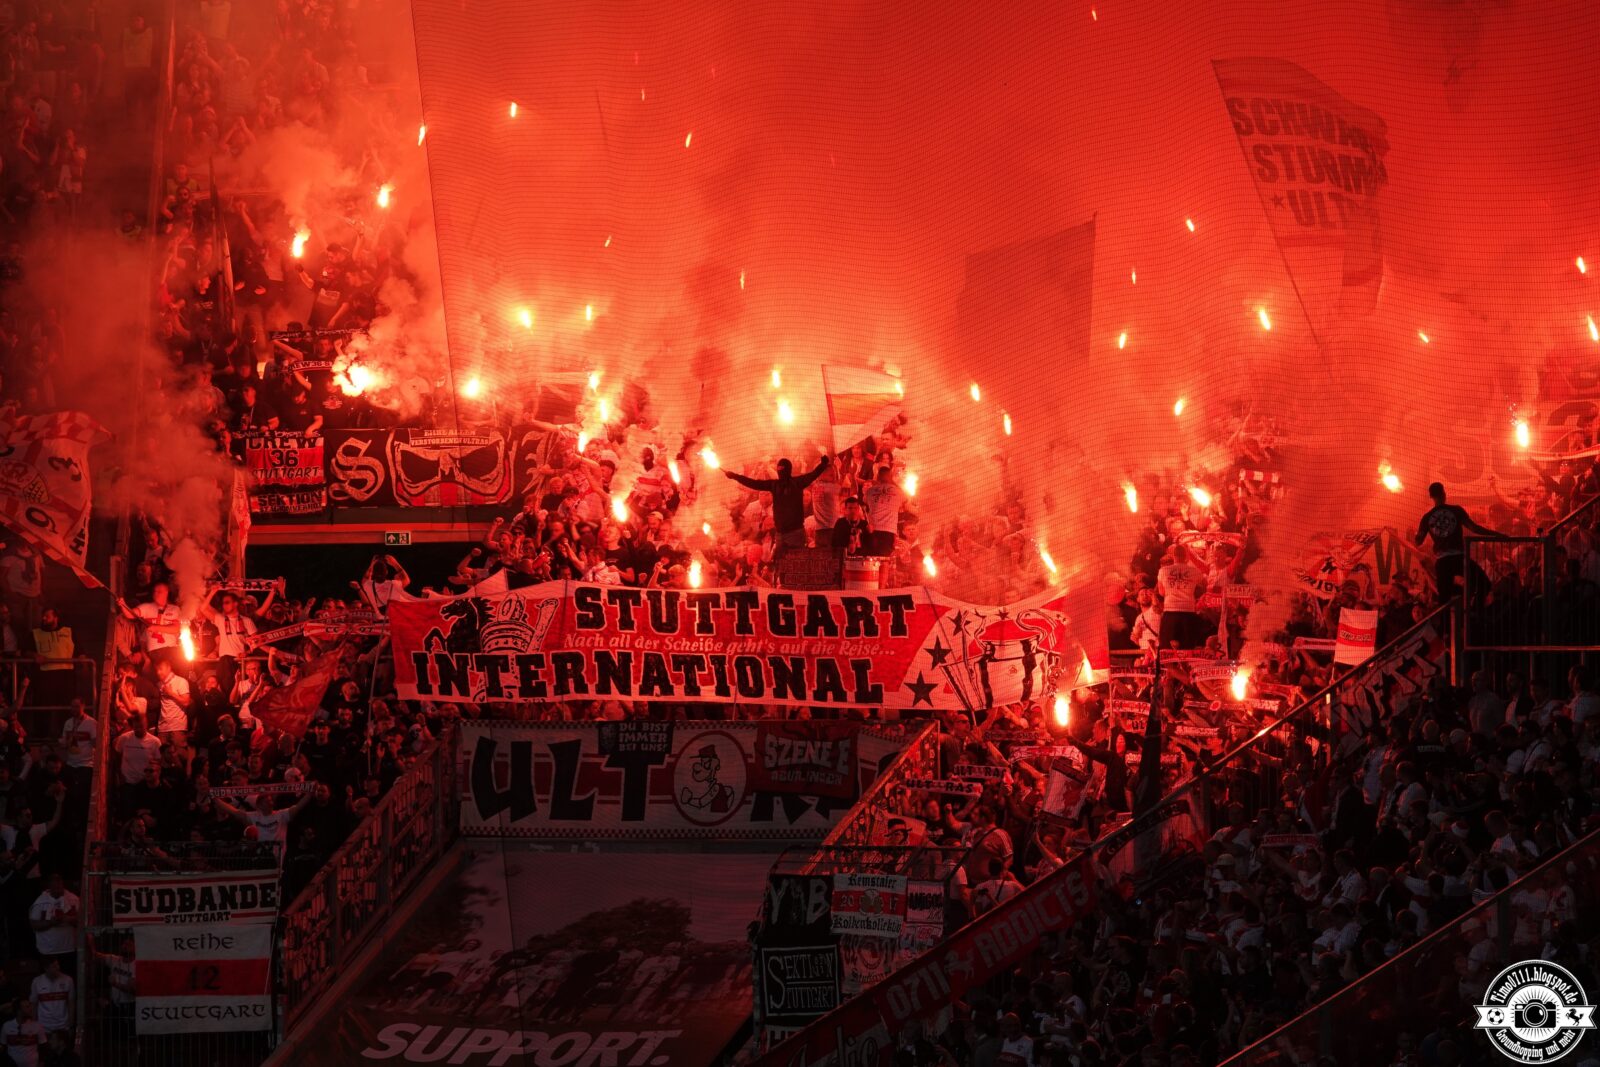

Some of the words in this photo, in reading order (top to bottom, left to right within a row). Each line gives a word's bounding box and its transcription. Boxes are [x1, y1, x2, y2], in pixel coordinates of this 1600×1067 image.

[271, 450, 299, 467] 36
[252, 466, 320, 480] STUTTGART
[258, 491, 322, 507] SEKTION
[574, 586, 916, 639] STUTTGART
[564, 634, 604, 649] Nach
[608, 635, 633, 649] all
[635, 635, 660, 650] der
[663, 636, 722, 652] Scheiße
[726, 638, 775, 656] geht's
[779, 640, 808, 655] auf
[812, 640, 836, 655] die
[411, 650, 884, 704] INTERNATIONAL
[618, 732, 668, 743] IMMER
[619, 722, 637, 732] DU
[642, 722, 669, 732] BIST
[618, 742, 637, 752] BEI
[764, 733, 833, 769] SZENE
[114, 882, 277, 913] SÜDBANDE
[163, 911, 231, 925] STUTTGART
[886, 961, 952, 1021] 0711
[973, 870, 1091, 969] ADDICTS
[190, 965, 222, 992] 12
[141, 1002, 266, 1022] STUTTGART
[360, 1022, 684, 1067] SUPPORT.
